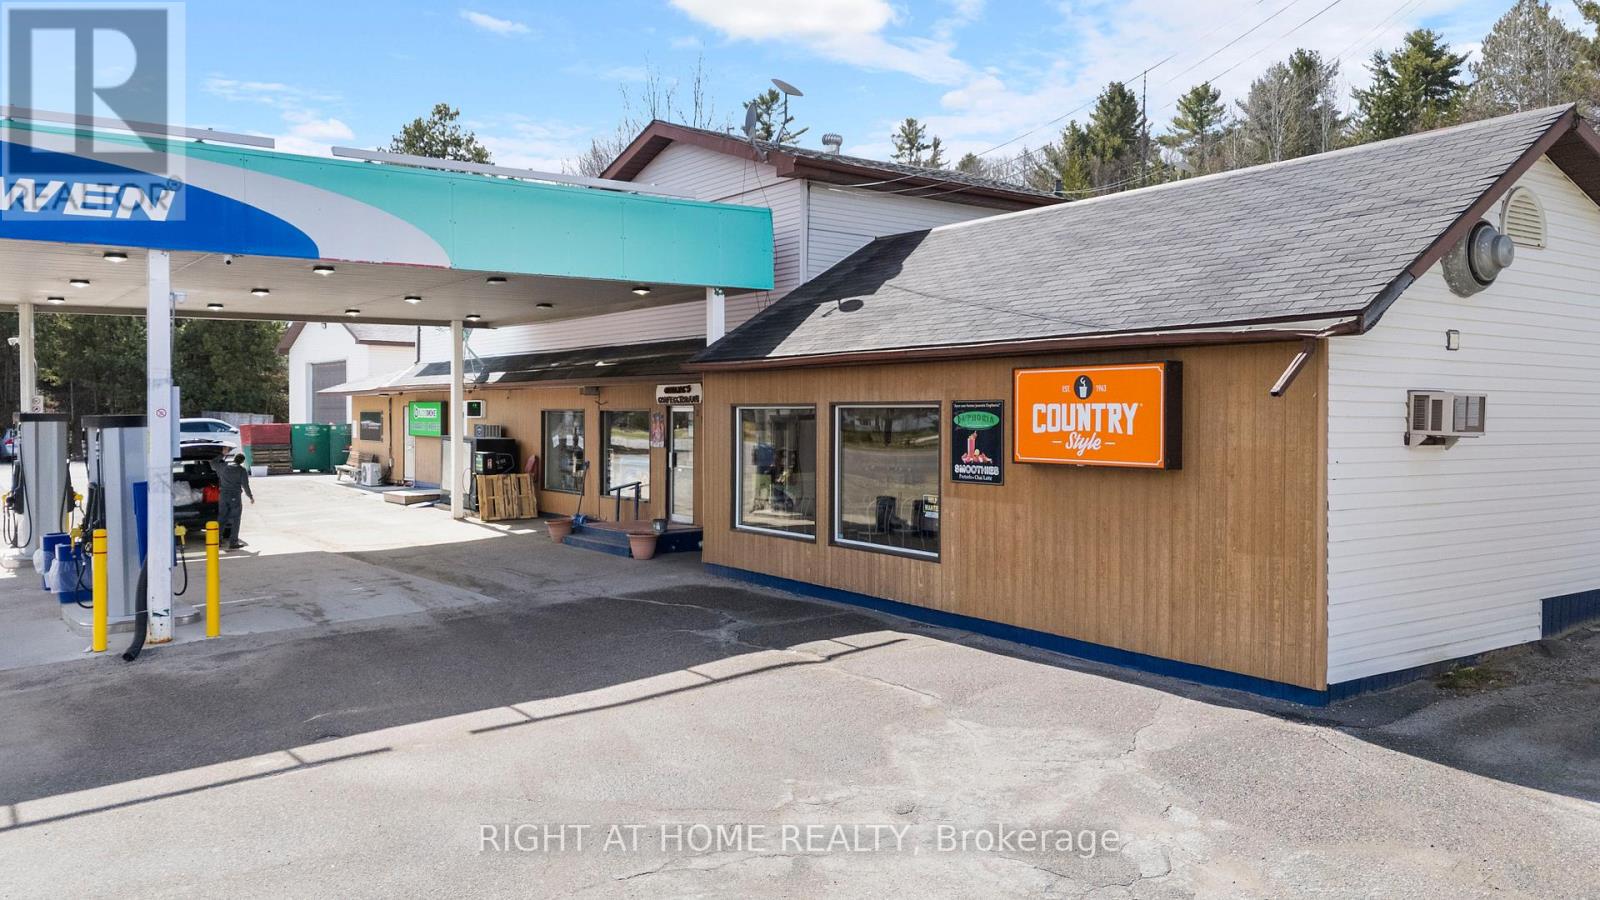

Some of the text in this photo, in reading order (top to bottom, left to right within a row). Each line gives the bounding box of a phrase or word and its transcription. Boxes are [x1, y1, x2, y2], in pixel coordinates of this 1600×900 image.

[1032, 402, 1139, 435] COUNTRY
[1065, 431, 1102, 456] Style
[954, 464, 999, 475] SMOOTHIES
